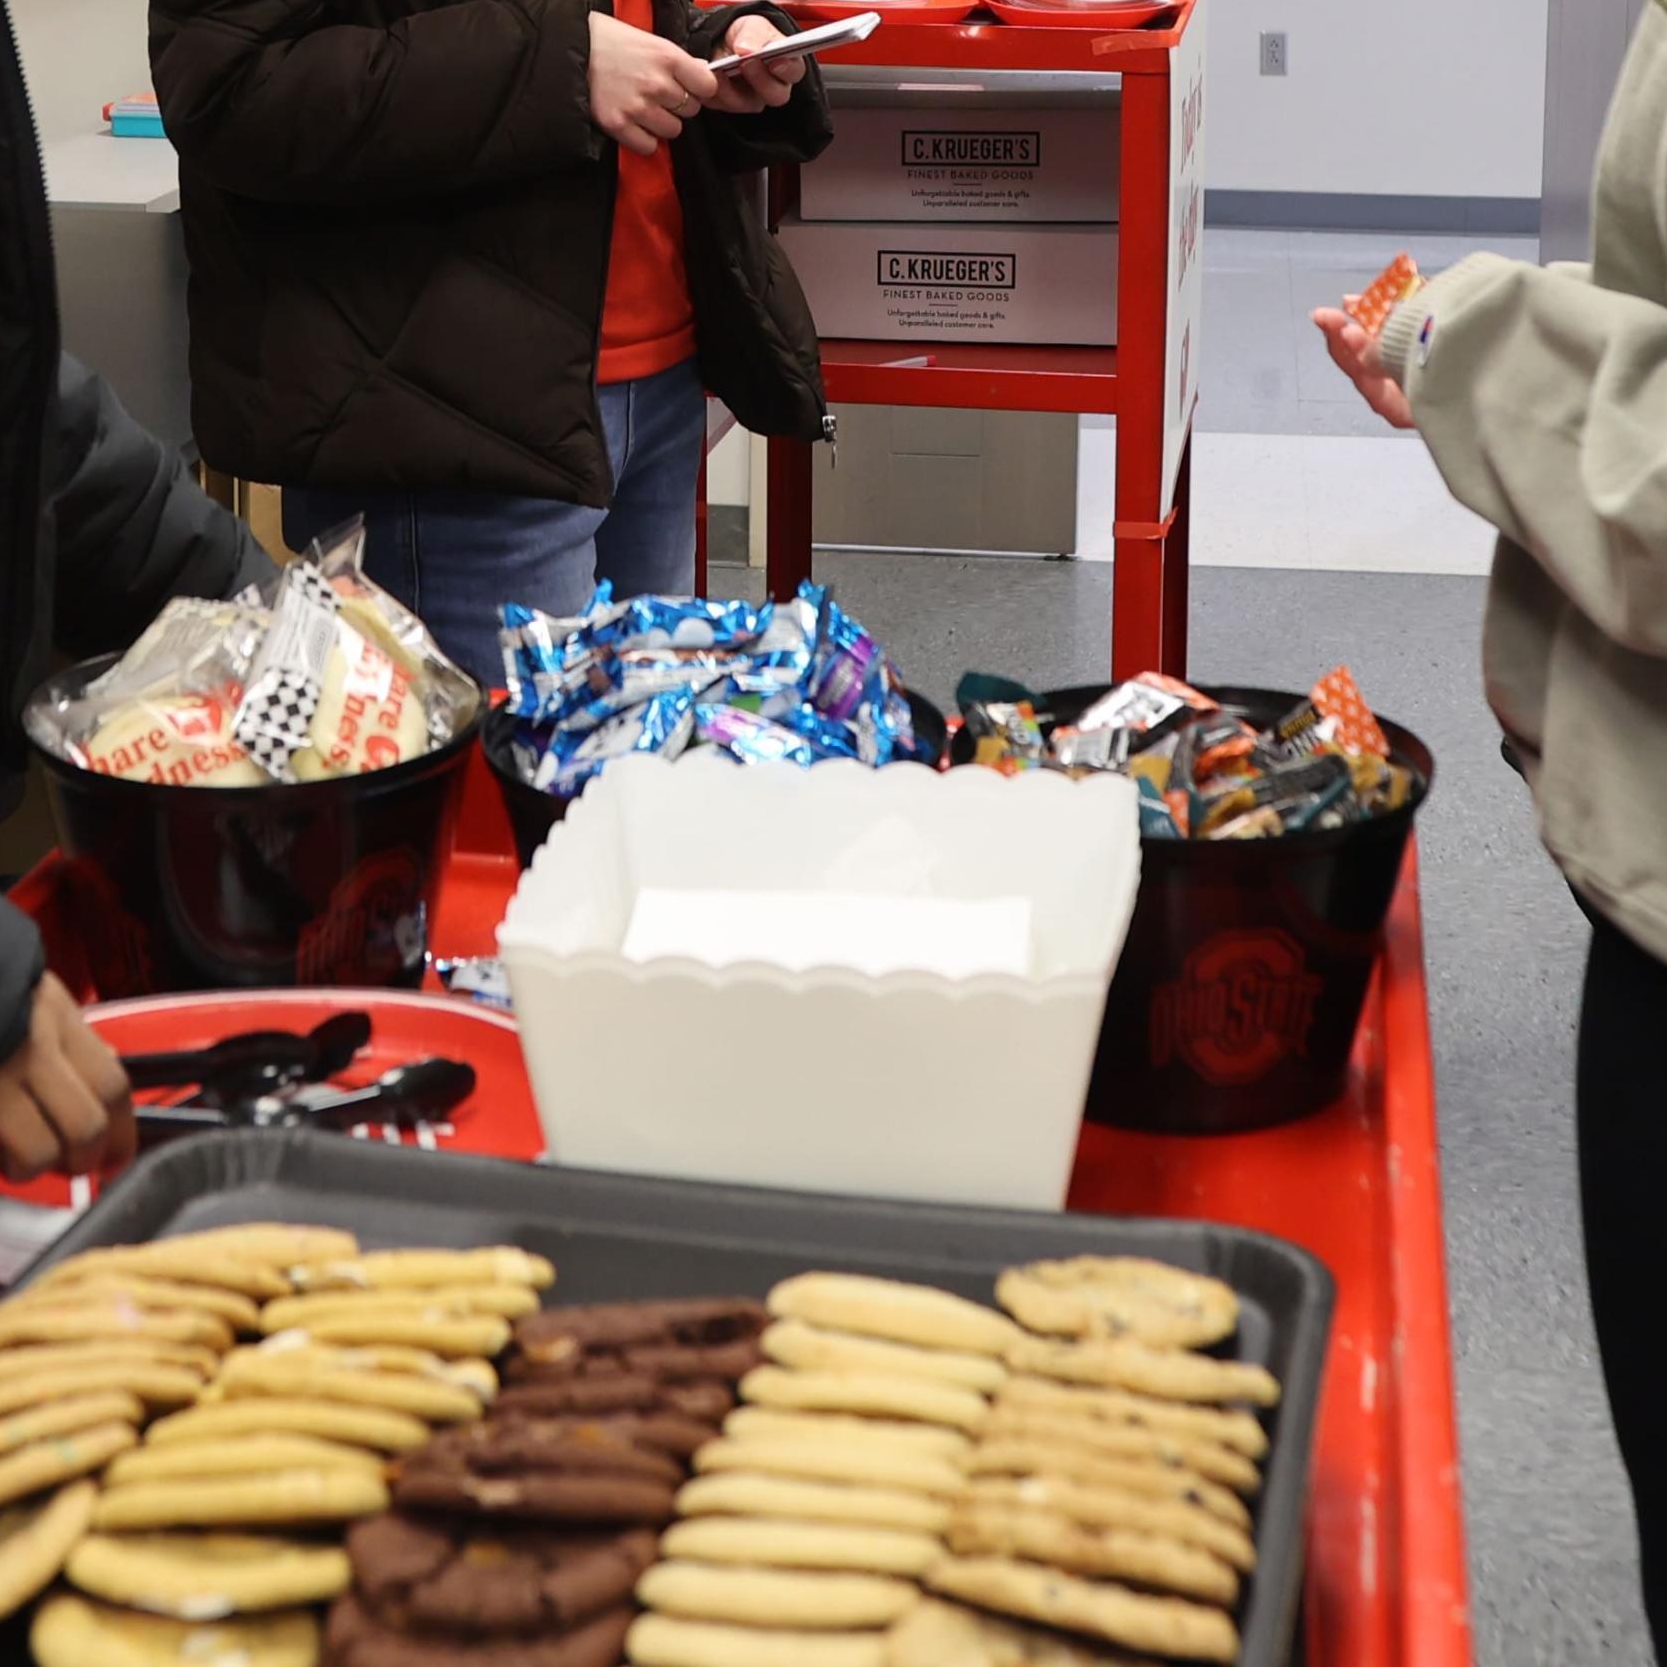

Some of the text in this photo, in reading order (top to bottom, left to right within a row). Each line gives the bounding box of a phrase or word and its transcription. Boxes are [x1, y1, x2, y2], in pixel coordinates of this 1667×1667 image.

[908, 170, 1034, 181] FINEST BAKED GOODS
[883, 289, 1010, 303] FINEST BAKED GOODS
[887, 309, 936, 319] Unforgettable
[937, 310, 959, 318] baked
[960, 311, 982, 320] goods
[898, 319, 944, 328] Unparalleled
[945, 320, 977, 328] customer
[84, 727, 171, 776] hare
